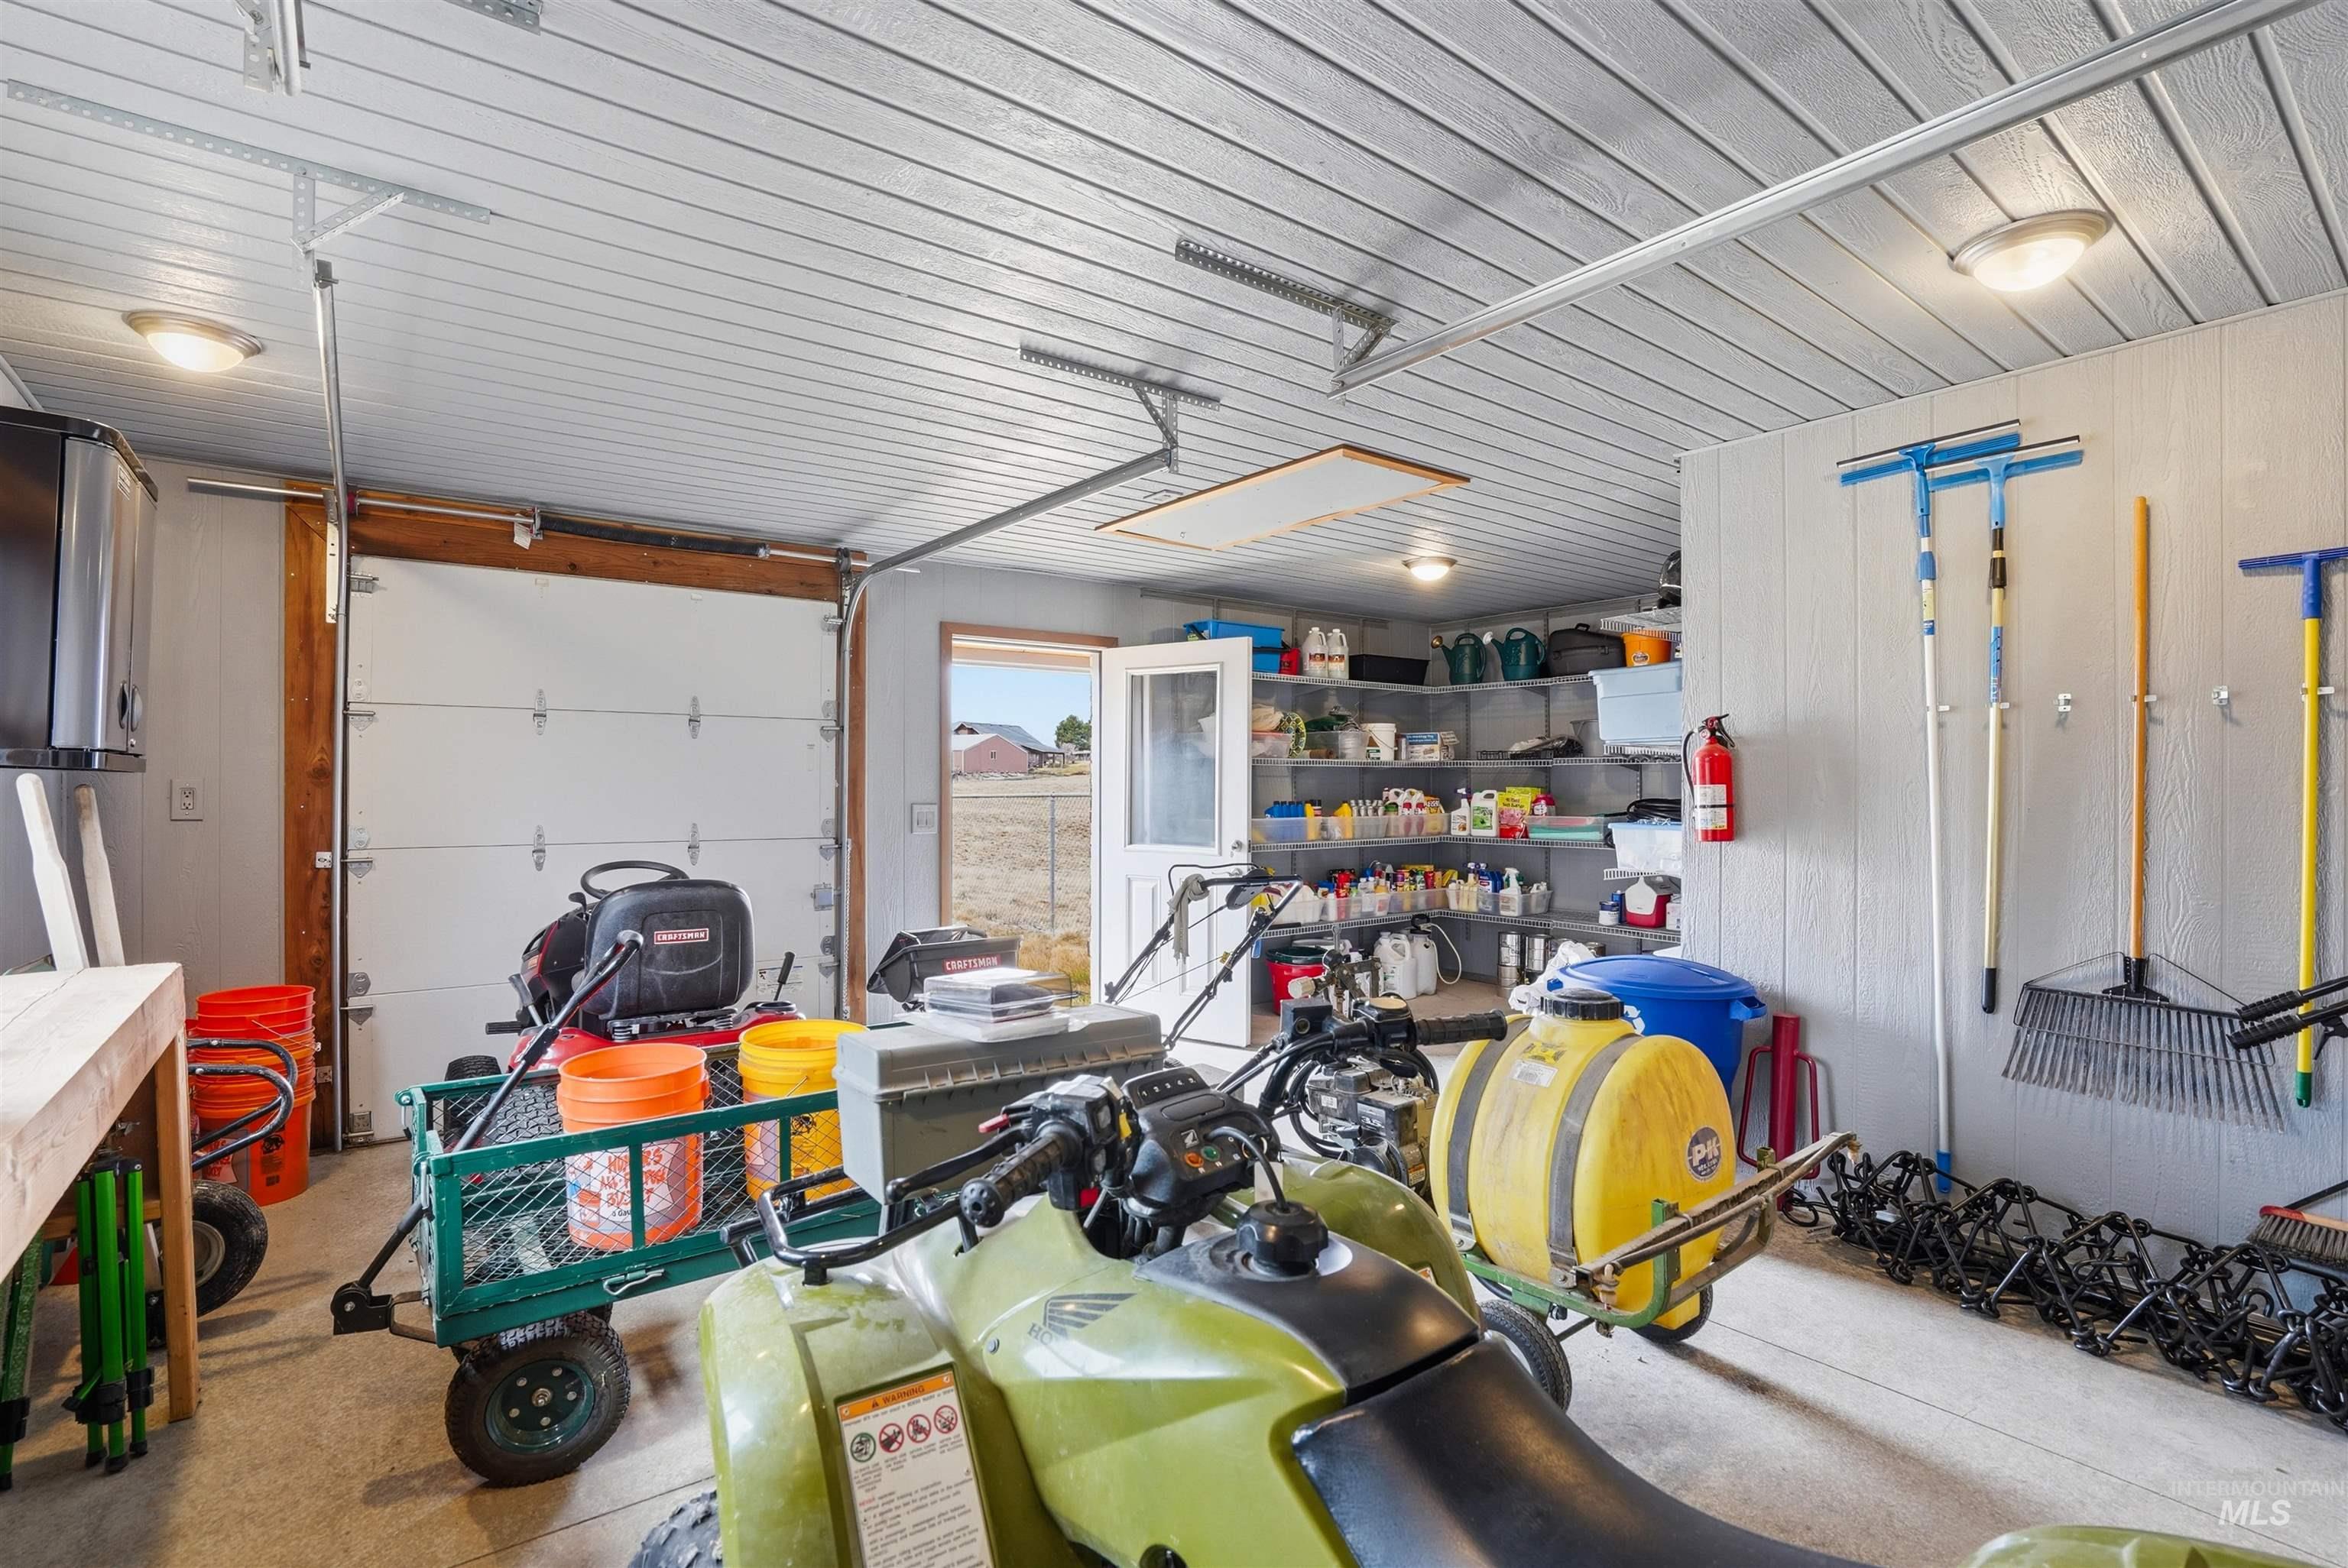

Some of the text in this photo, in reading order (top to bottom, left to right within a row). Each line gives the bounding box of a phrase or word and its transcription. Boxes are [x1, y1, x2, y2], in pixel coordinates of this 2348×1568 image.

[657, 931, 705, 942] CRAFTSMAN
[945, 956, 998, 972] CRAFTSMAN
[883, 1385, 925, 1404] WARNING
